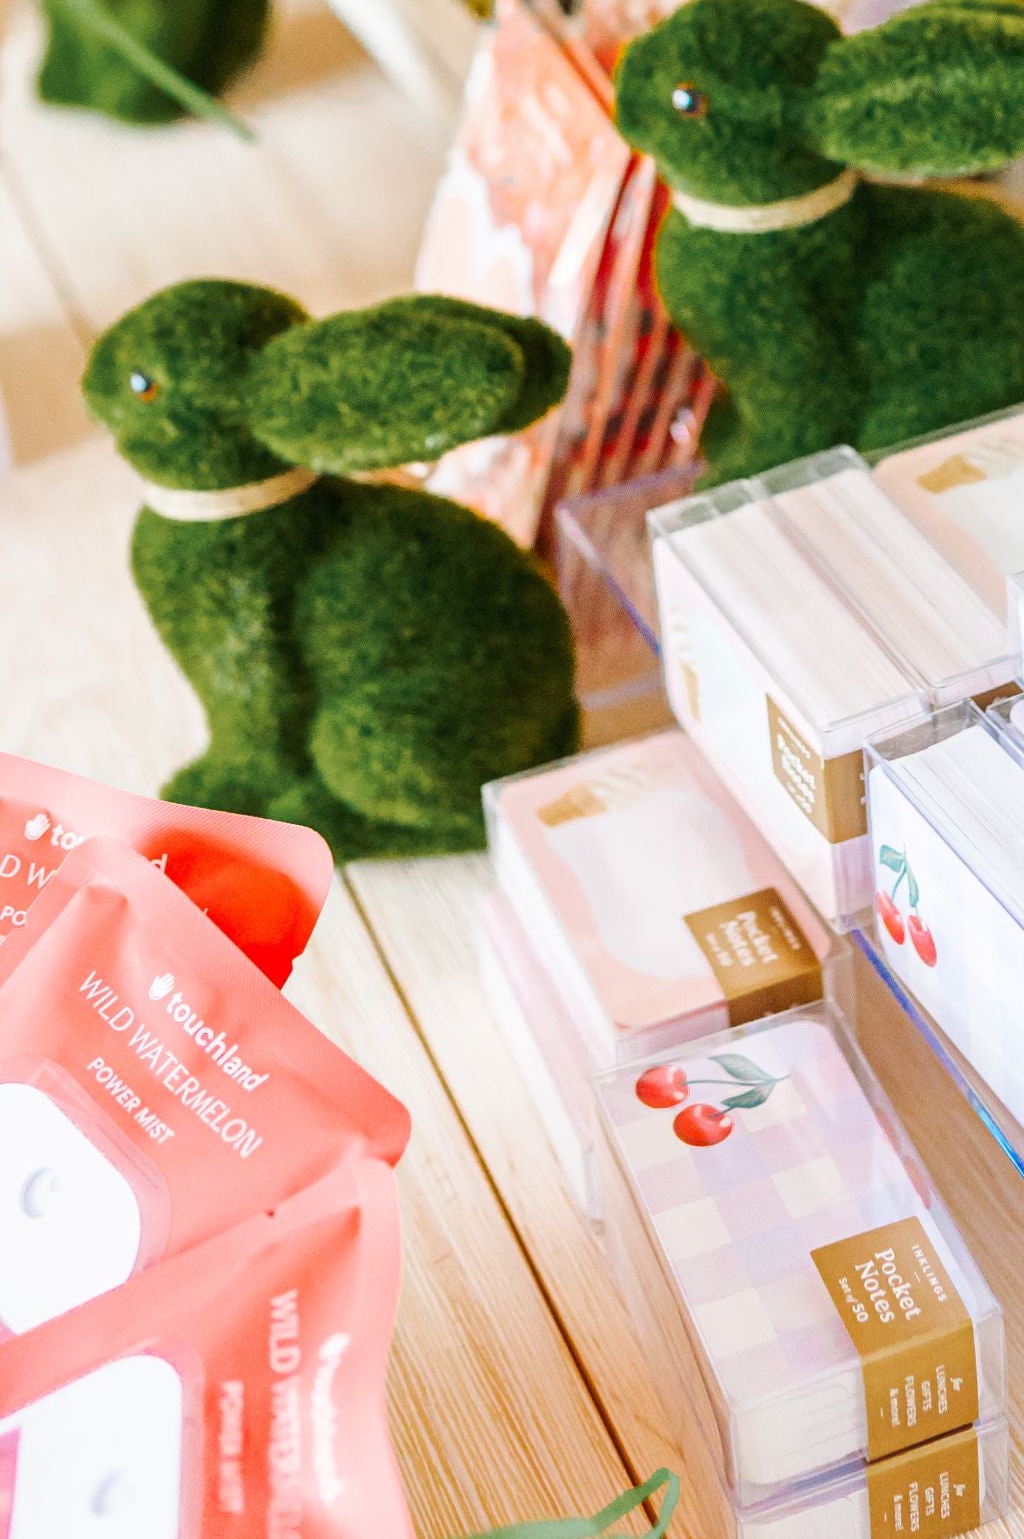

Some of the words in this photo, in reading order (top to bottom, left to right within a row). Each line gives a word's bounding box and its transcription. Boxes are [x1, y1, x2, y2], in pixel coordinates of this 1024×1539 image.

[79, 970, 135, 1033] WILD
[128, 1023, 264, 1160] WATERMELON
[166, 992, 269, 1093] touchland
[86, 1056, 141, 1114] POWER
[134, 1106, 176, 1145] MIST
[854, 1259, 896, 1324] Notes
[874, 1246, 922, 1321] Pocket
[911, 1244, 948, 1303] INKLINGS
[268, 1288, 302, 1374] WILD
[852, 1299, 869, 1323] 50
[904, 1374, 918, 1428] FLOWERS
[921, 1380, 932, 1412] GIFTS
[935, 1364, 949, 1414] LUNCHES
[909, 1481, 920, 1532] FLOWERS
[924, 1486, 935, 1517] GIFTS
[938, 1471, 951, 1519] LUNCHES
